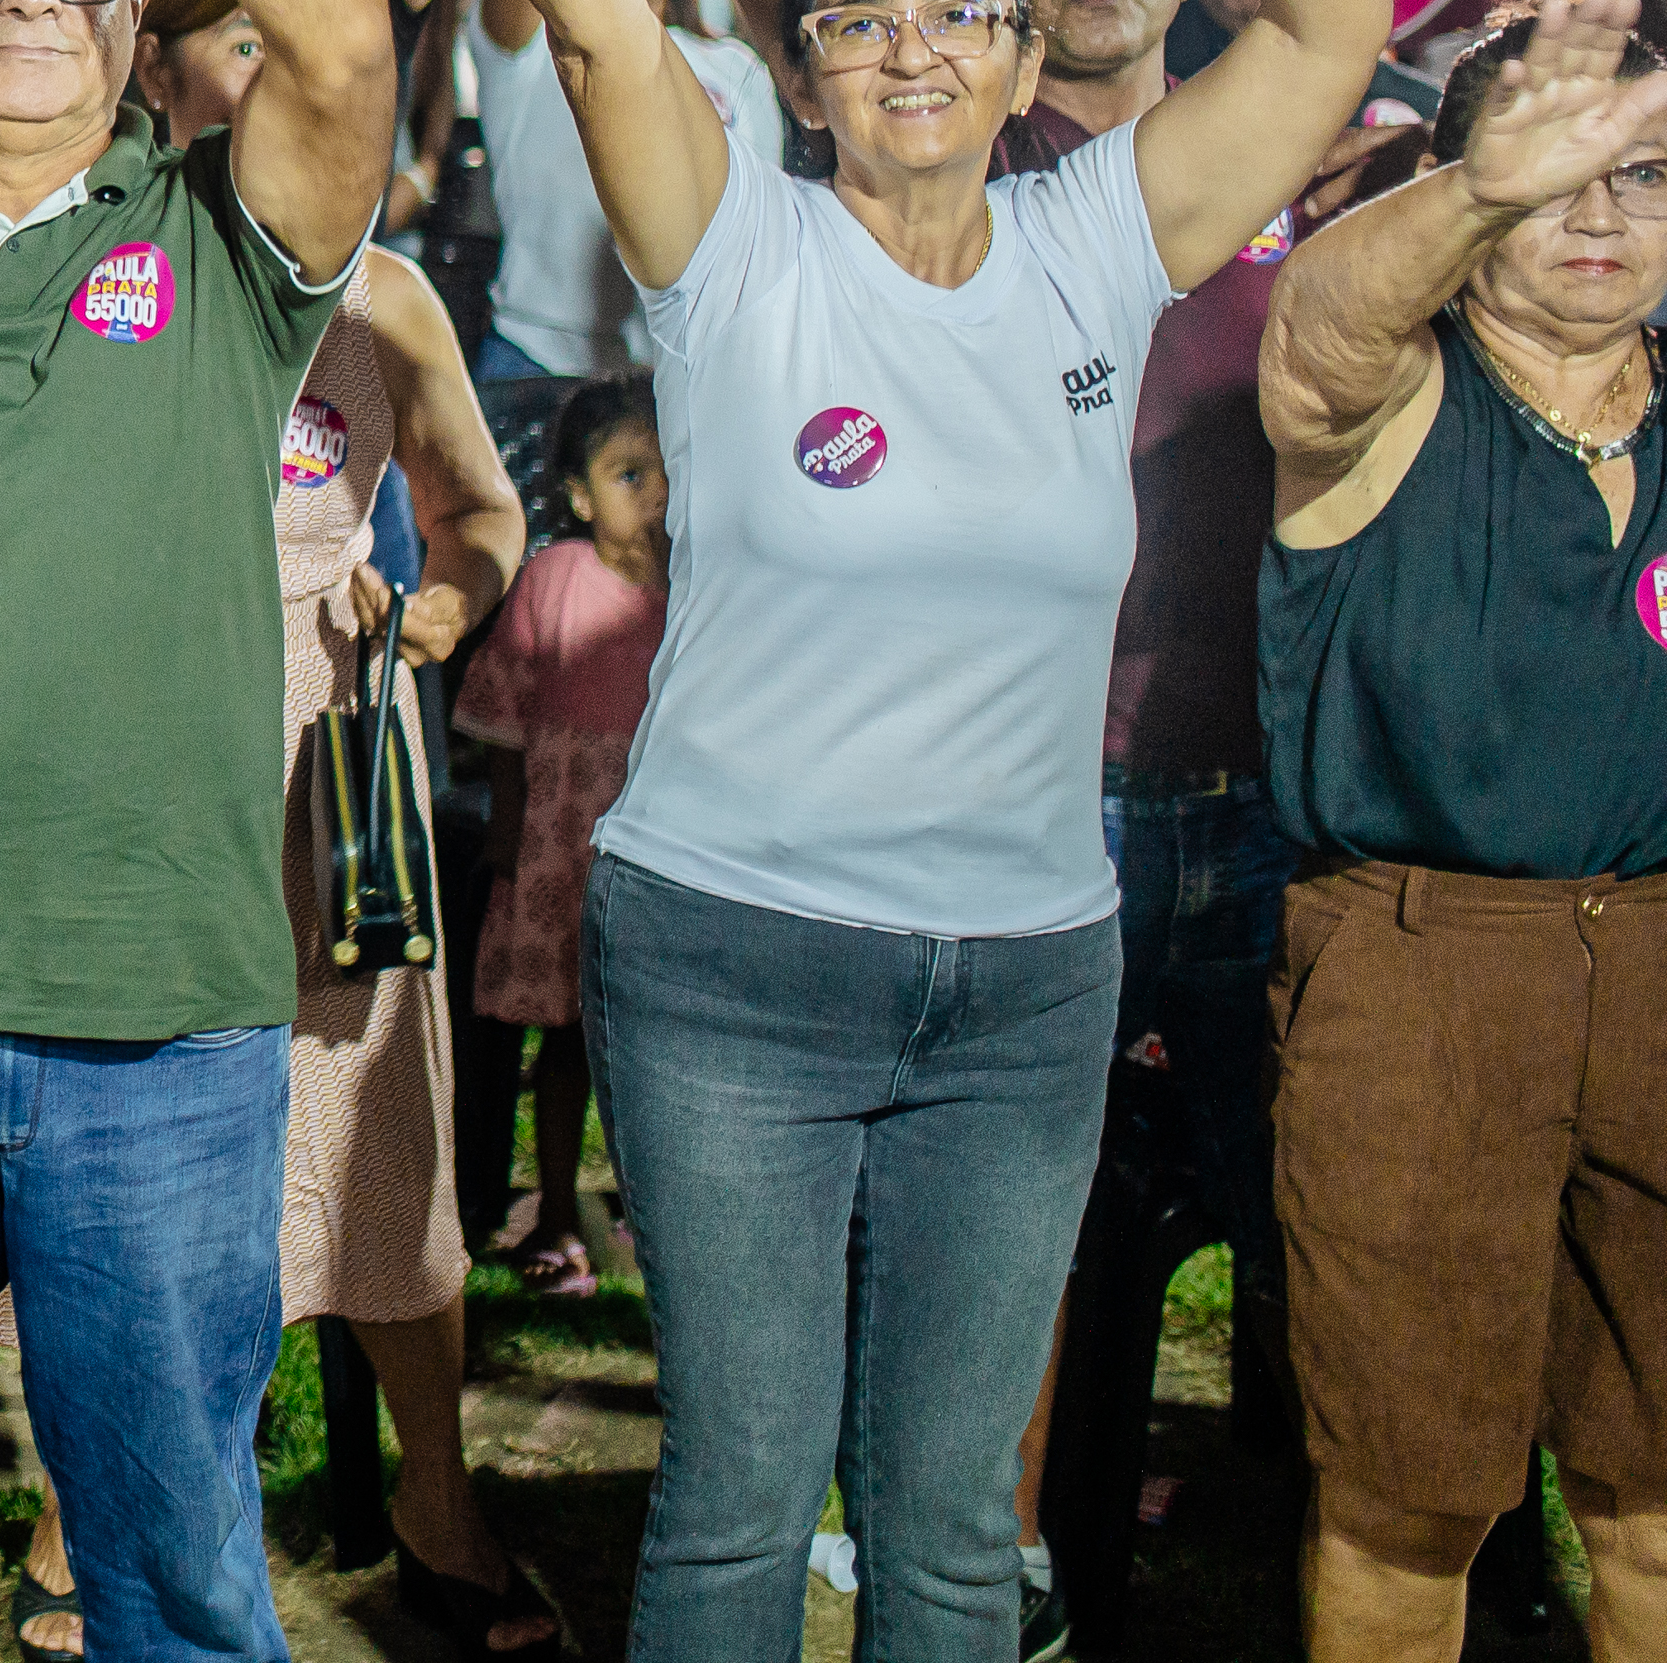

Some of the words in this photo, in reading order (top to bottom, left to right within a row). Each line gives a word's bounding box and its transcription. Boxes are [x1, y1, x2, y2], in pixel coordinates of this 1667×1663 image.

[88, 256, 159, 285] PAULA
[87, 280, 158, 299] PRATA
[85, 292, 158, 328] 55000
[802, 413, 878, 474] Paula
[827, 435, 877, 475] Prata
